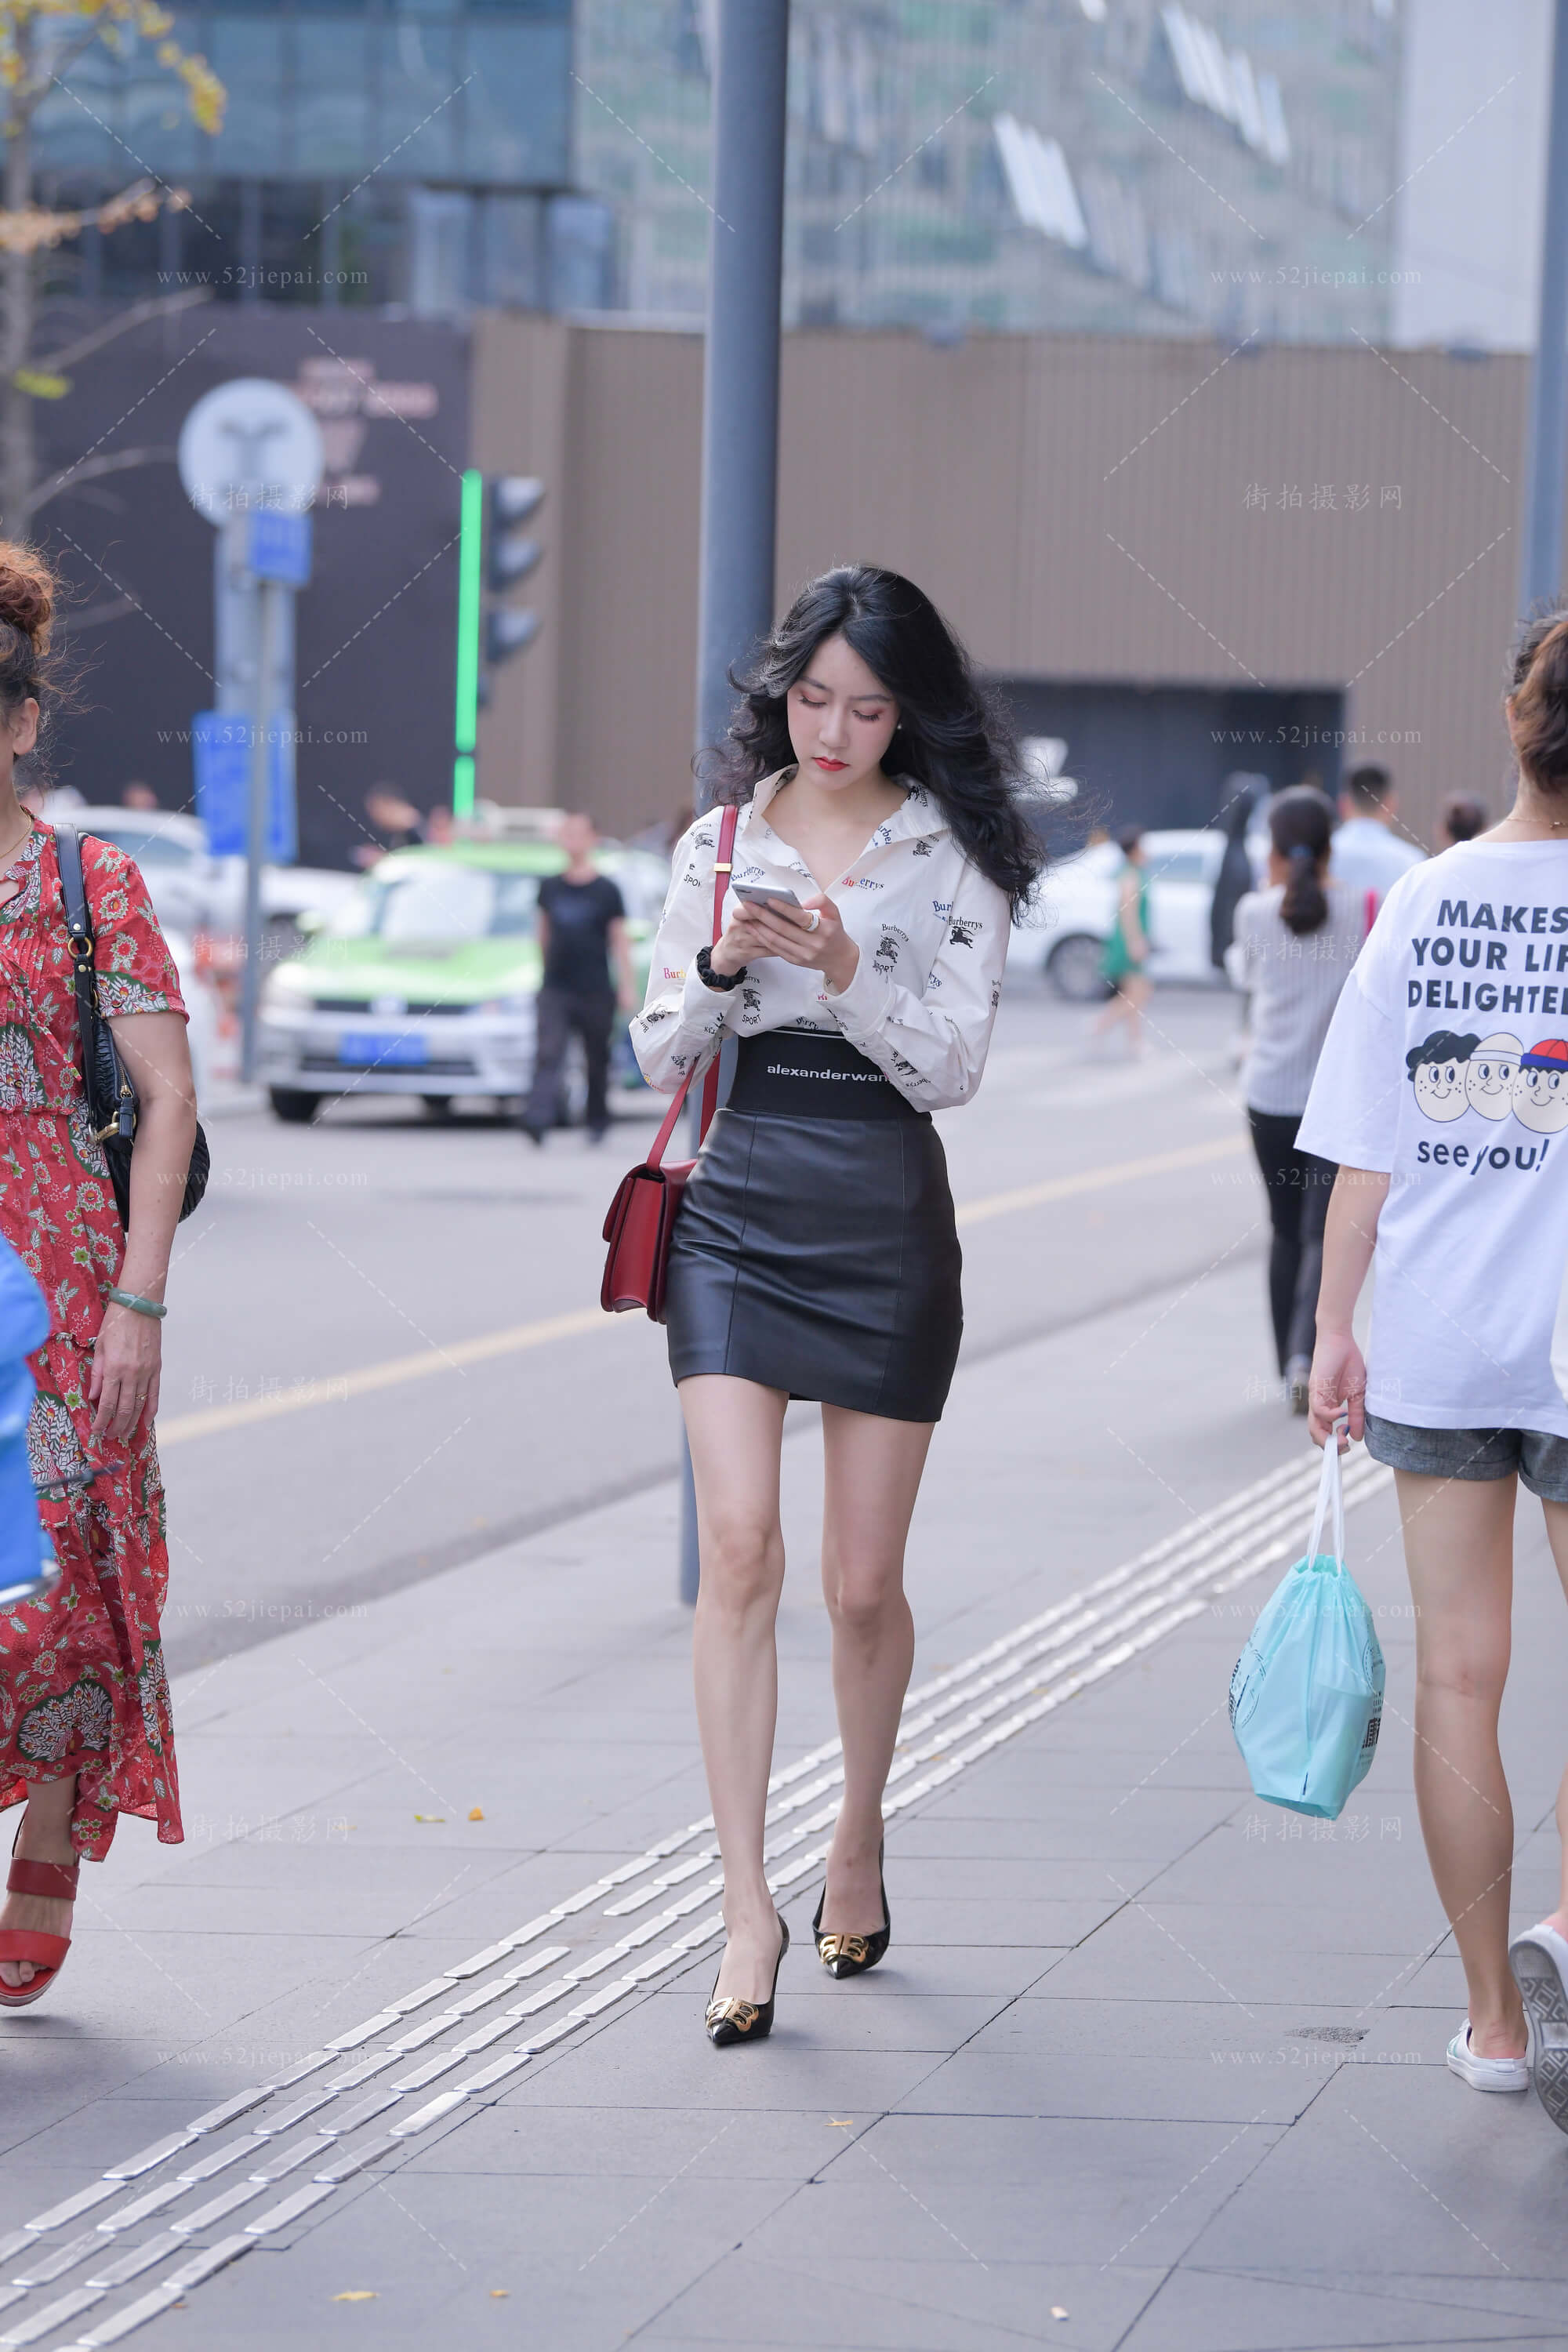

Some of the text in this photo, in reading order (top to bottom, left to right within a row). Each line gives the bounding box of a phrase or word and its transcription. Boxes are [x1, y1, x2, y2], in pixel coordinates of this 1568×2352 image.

[949, 916, 983, 930] Burberrys
[1436, 899, 1568, 935] MAKES
[882, 924, 909, 942] Burberrys
[1412, 937, 1508, 971] YOUR
[742, 1014, 762, 1025] SPORT
[1417, 1138, 1550, 1175] see you!
